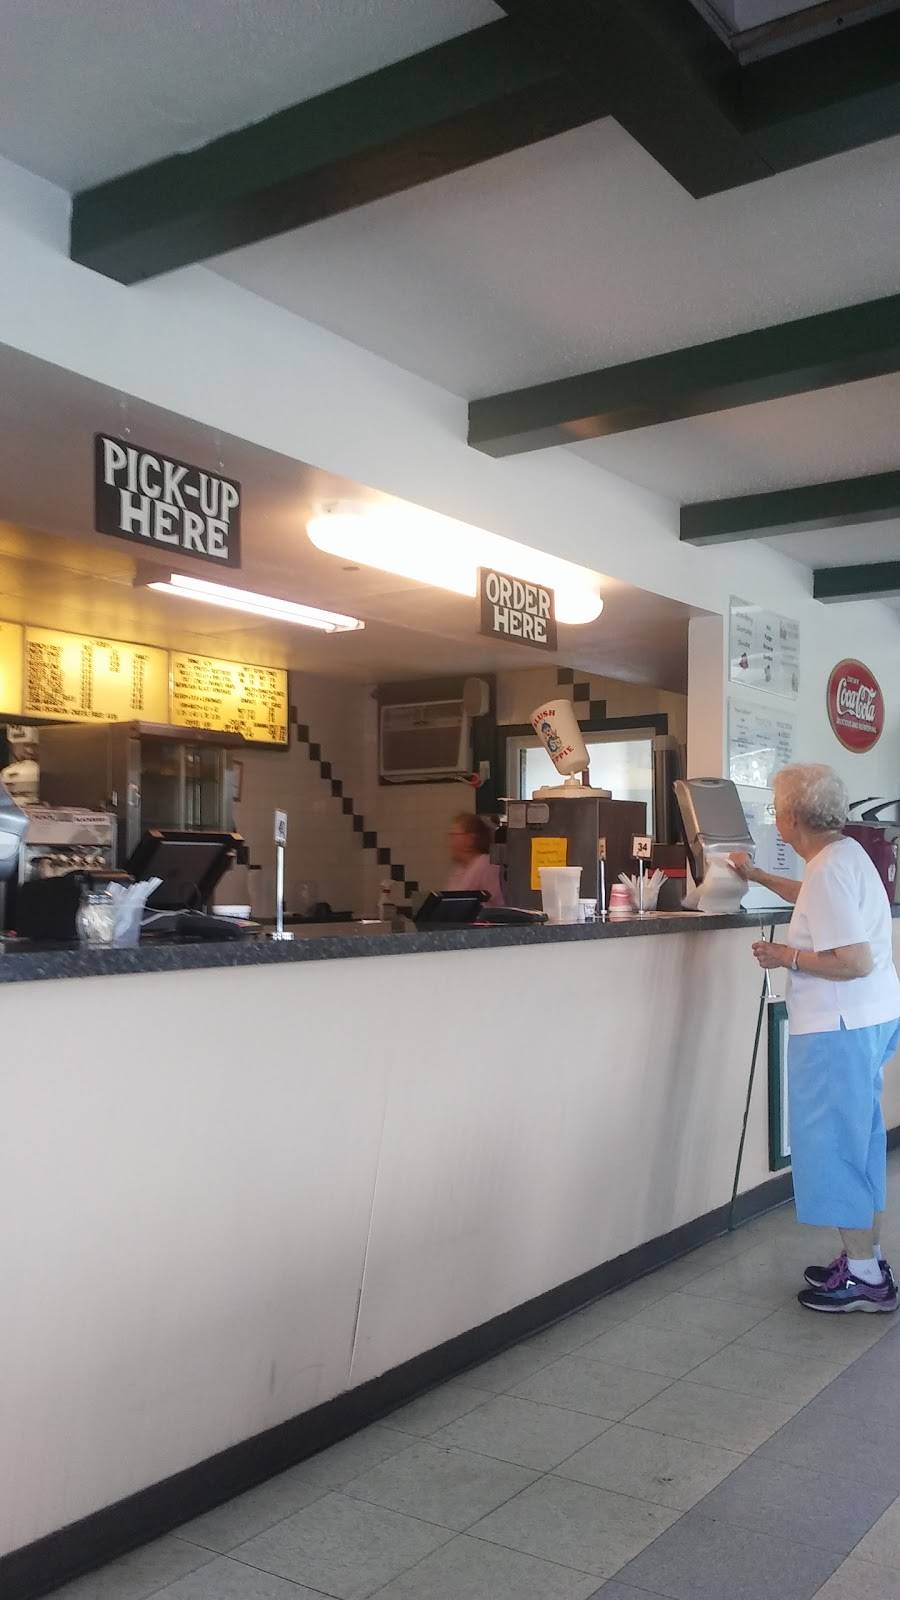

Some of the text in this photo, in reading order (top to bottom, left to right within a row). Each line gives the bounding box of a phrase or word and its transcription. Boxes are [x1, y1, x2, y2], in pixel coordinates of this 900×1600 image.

[102, 438, 240, 524] PICK-UP
[119, 488, 229, 559] HERE
[486, 573, 551, 619] ORDER
[493, 605, 547, 643] HERE
[637, 842, 648, 852] 34
